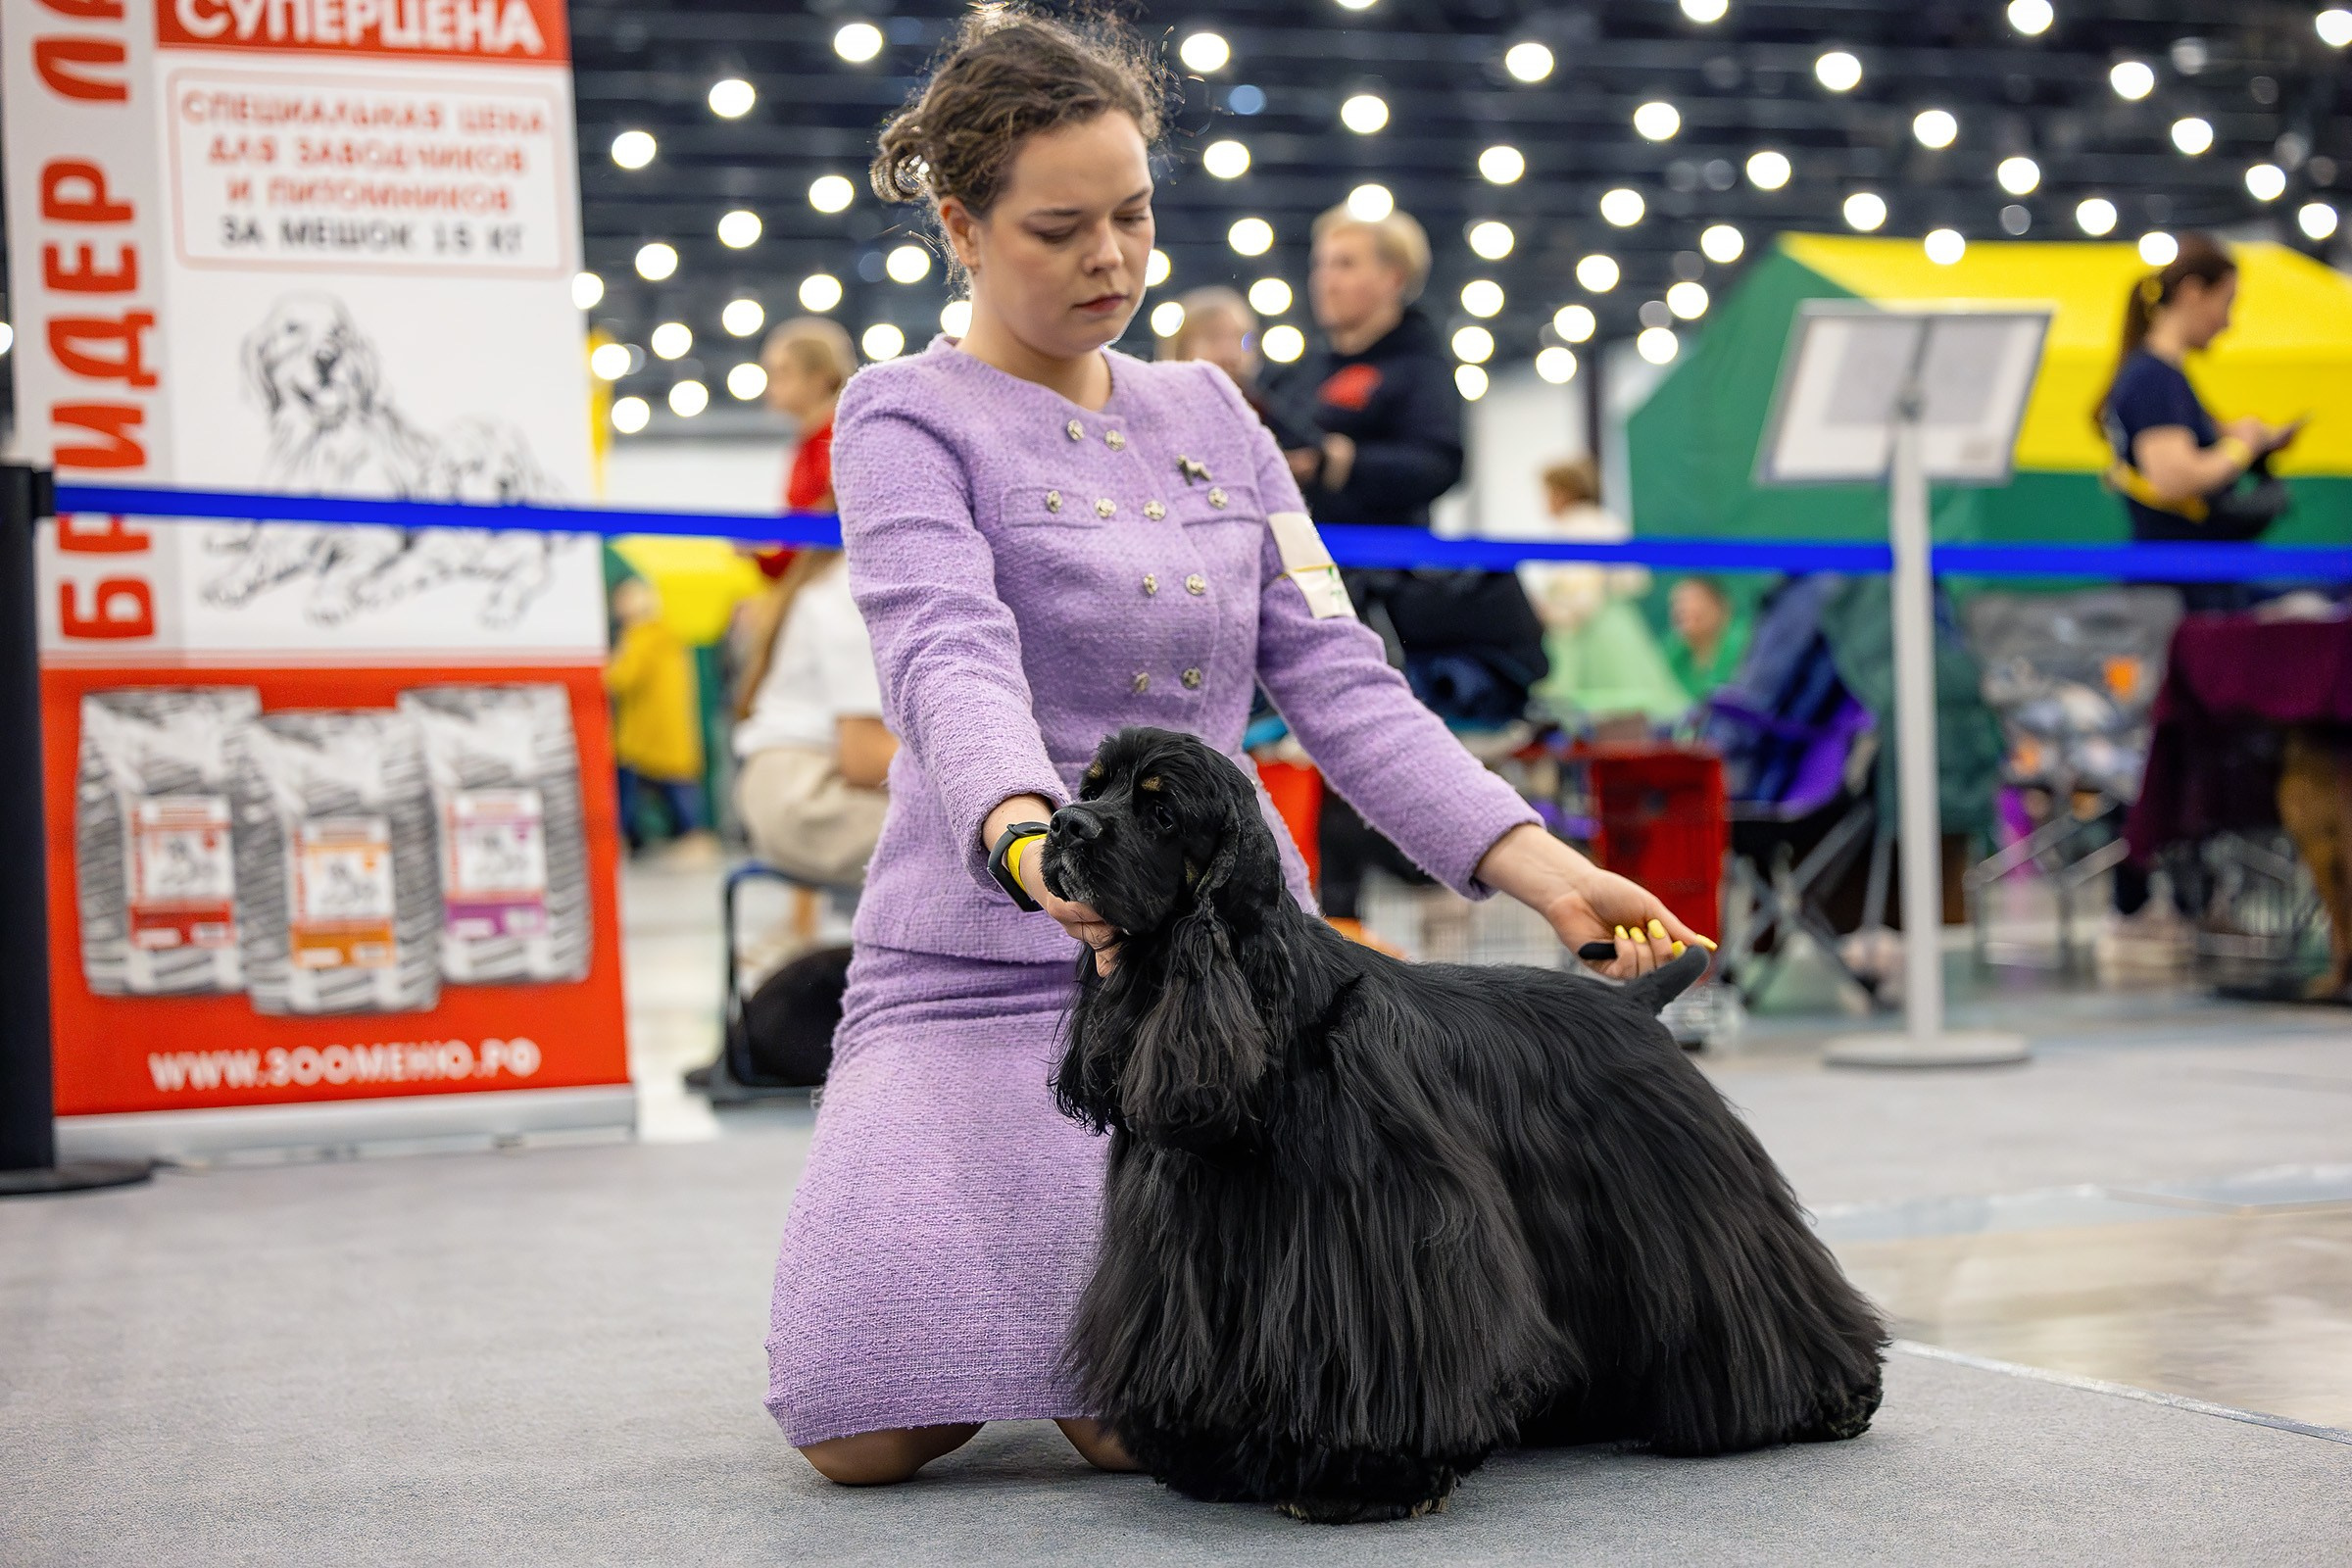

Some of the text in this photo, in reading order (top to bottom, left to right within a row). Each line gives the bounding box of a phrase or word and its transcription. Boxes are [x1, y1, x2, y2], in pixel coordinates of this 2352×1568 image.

[175, 0, 546, 55] СУПЕРЦЕНА
[182, 91, 547, 135] СПЕЦИАЛЬНАЯ ЦЕНА
[209, 135, 526, 174] ДЛЯ ЗАВОДЧИКОВ
[226, 177, 512, 214] И ПИТОМНИКОВ
[221, 217, 263, 249] ЗА
[280, 220, 413, 252] МЕШОК
